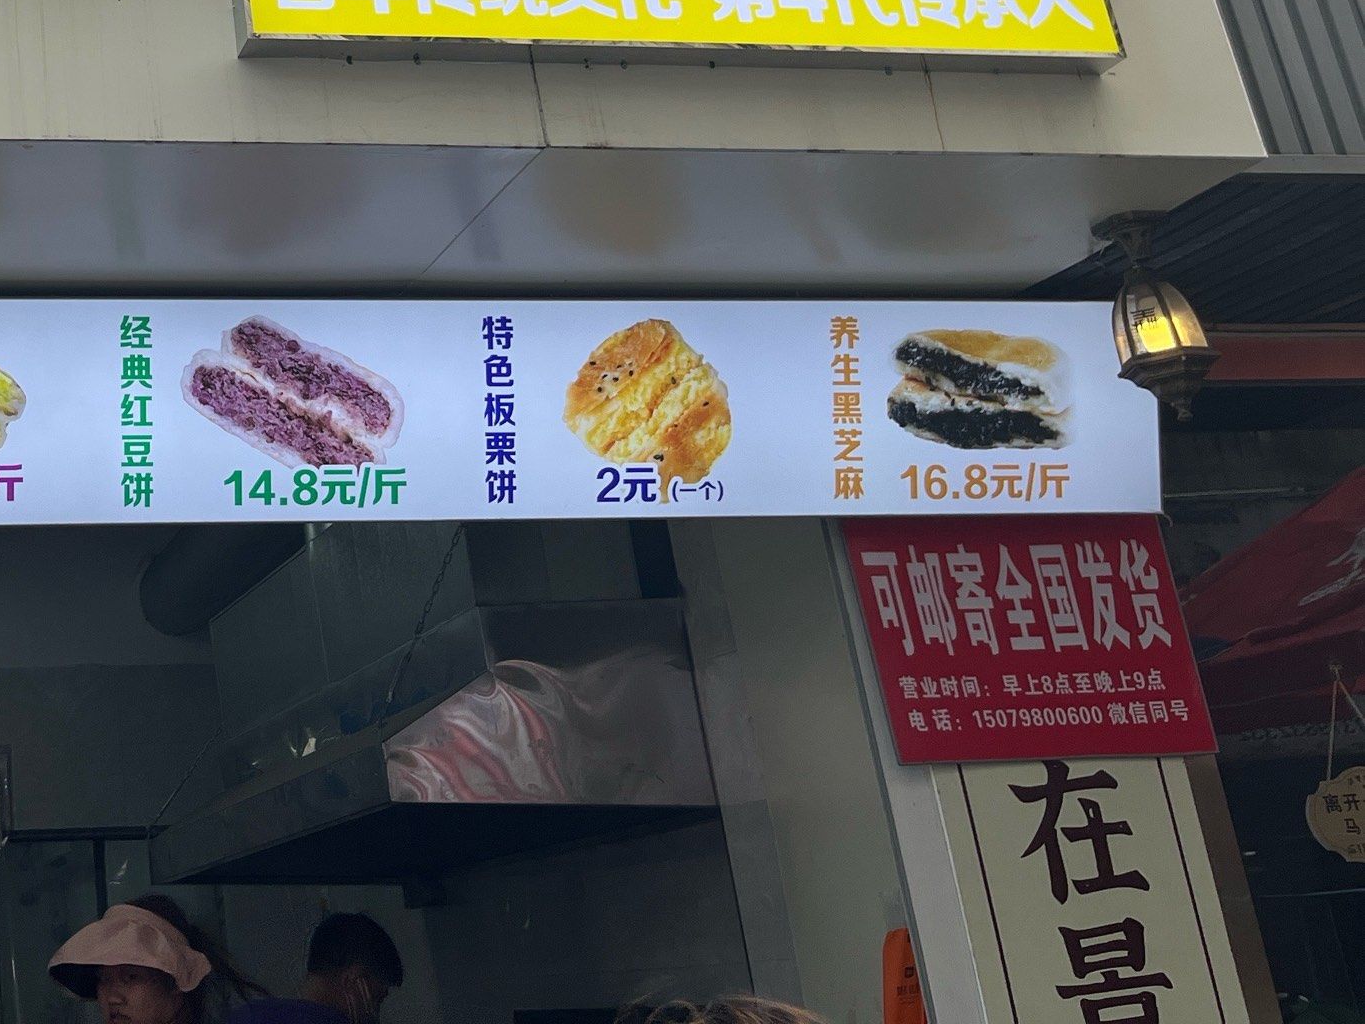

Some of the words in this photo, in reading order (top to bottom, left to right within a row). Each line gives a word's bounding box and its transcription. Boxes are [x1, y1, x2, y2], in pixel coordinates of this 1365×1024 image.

[120, 315, 154, 509] 经典红豆饼
[482, 315, 517, 506] 特色板栗饼
[830, 316, 866, 501] 养生黑芝麻
[223, 466, 408, 507] 14.8元/斤
[596, 466, 657, 504] 2元
[900, 462, 1071, 502] 16.8元/斤
[861, 539, 1173, 657] 可邮寄全国发货
[1106, 699, 1189, 726] 微信同号
